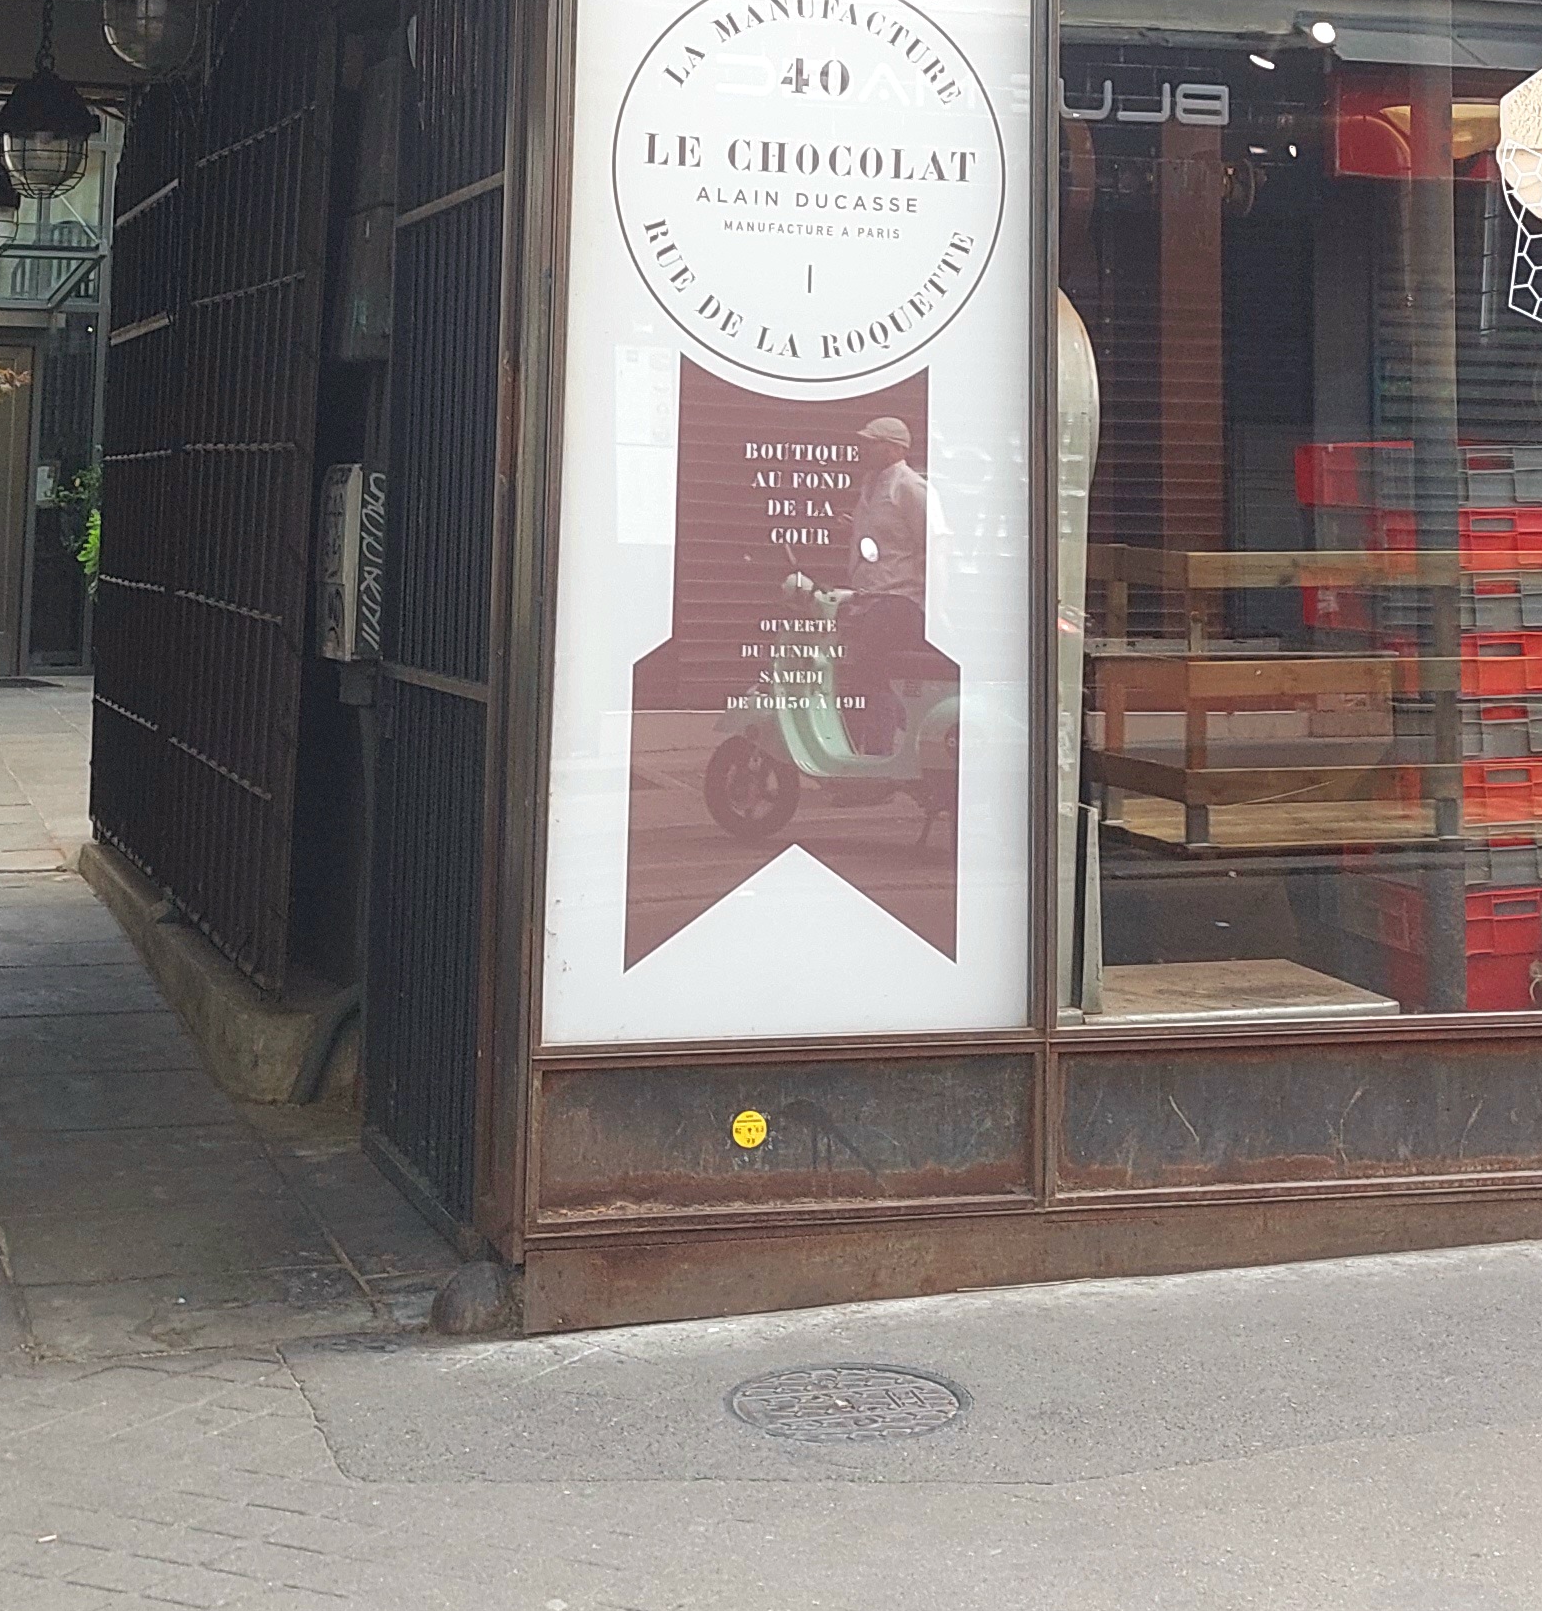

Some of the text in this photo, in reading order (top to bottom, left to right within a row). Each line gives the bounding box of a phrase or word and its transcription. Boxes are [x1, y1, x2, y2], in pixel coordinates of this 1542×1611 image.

[663, 46, 705, 88] LA
[780, 57, 850, 97] 40
[644, 132, 976, 183] LE CHOCOLAT
[696, 186, 918, 214] ALAIN DUCASSE
[724, 219, 834, 237] MANUFACTURE
[857, 227, 901, 240] PARIS
[643, 218, 975, 359] RUE DE LA ROQUETTE
[744, 442, 860, 465] BOUTIQUE
[751, 471, 851, 489] AU FOND
[767, 499, 834, 517] DE LA
[771, 527, 830, 545] COUR
[760, 619, 837, 632] OUVERTE
[741, 644, 847, 658] DU LUNDI AU
[759, 670, 823, 685] SAMEDI
[726, 696, 749, 709] DE
